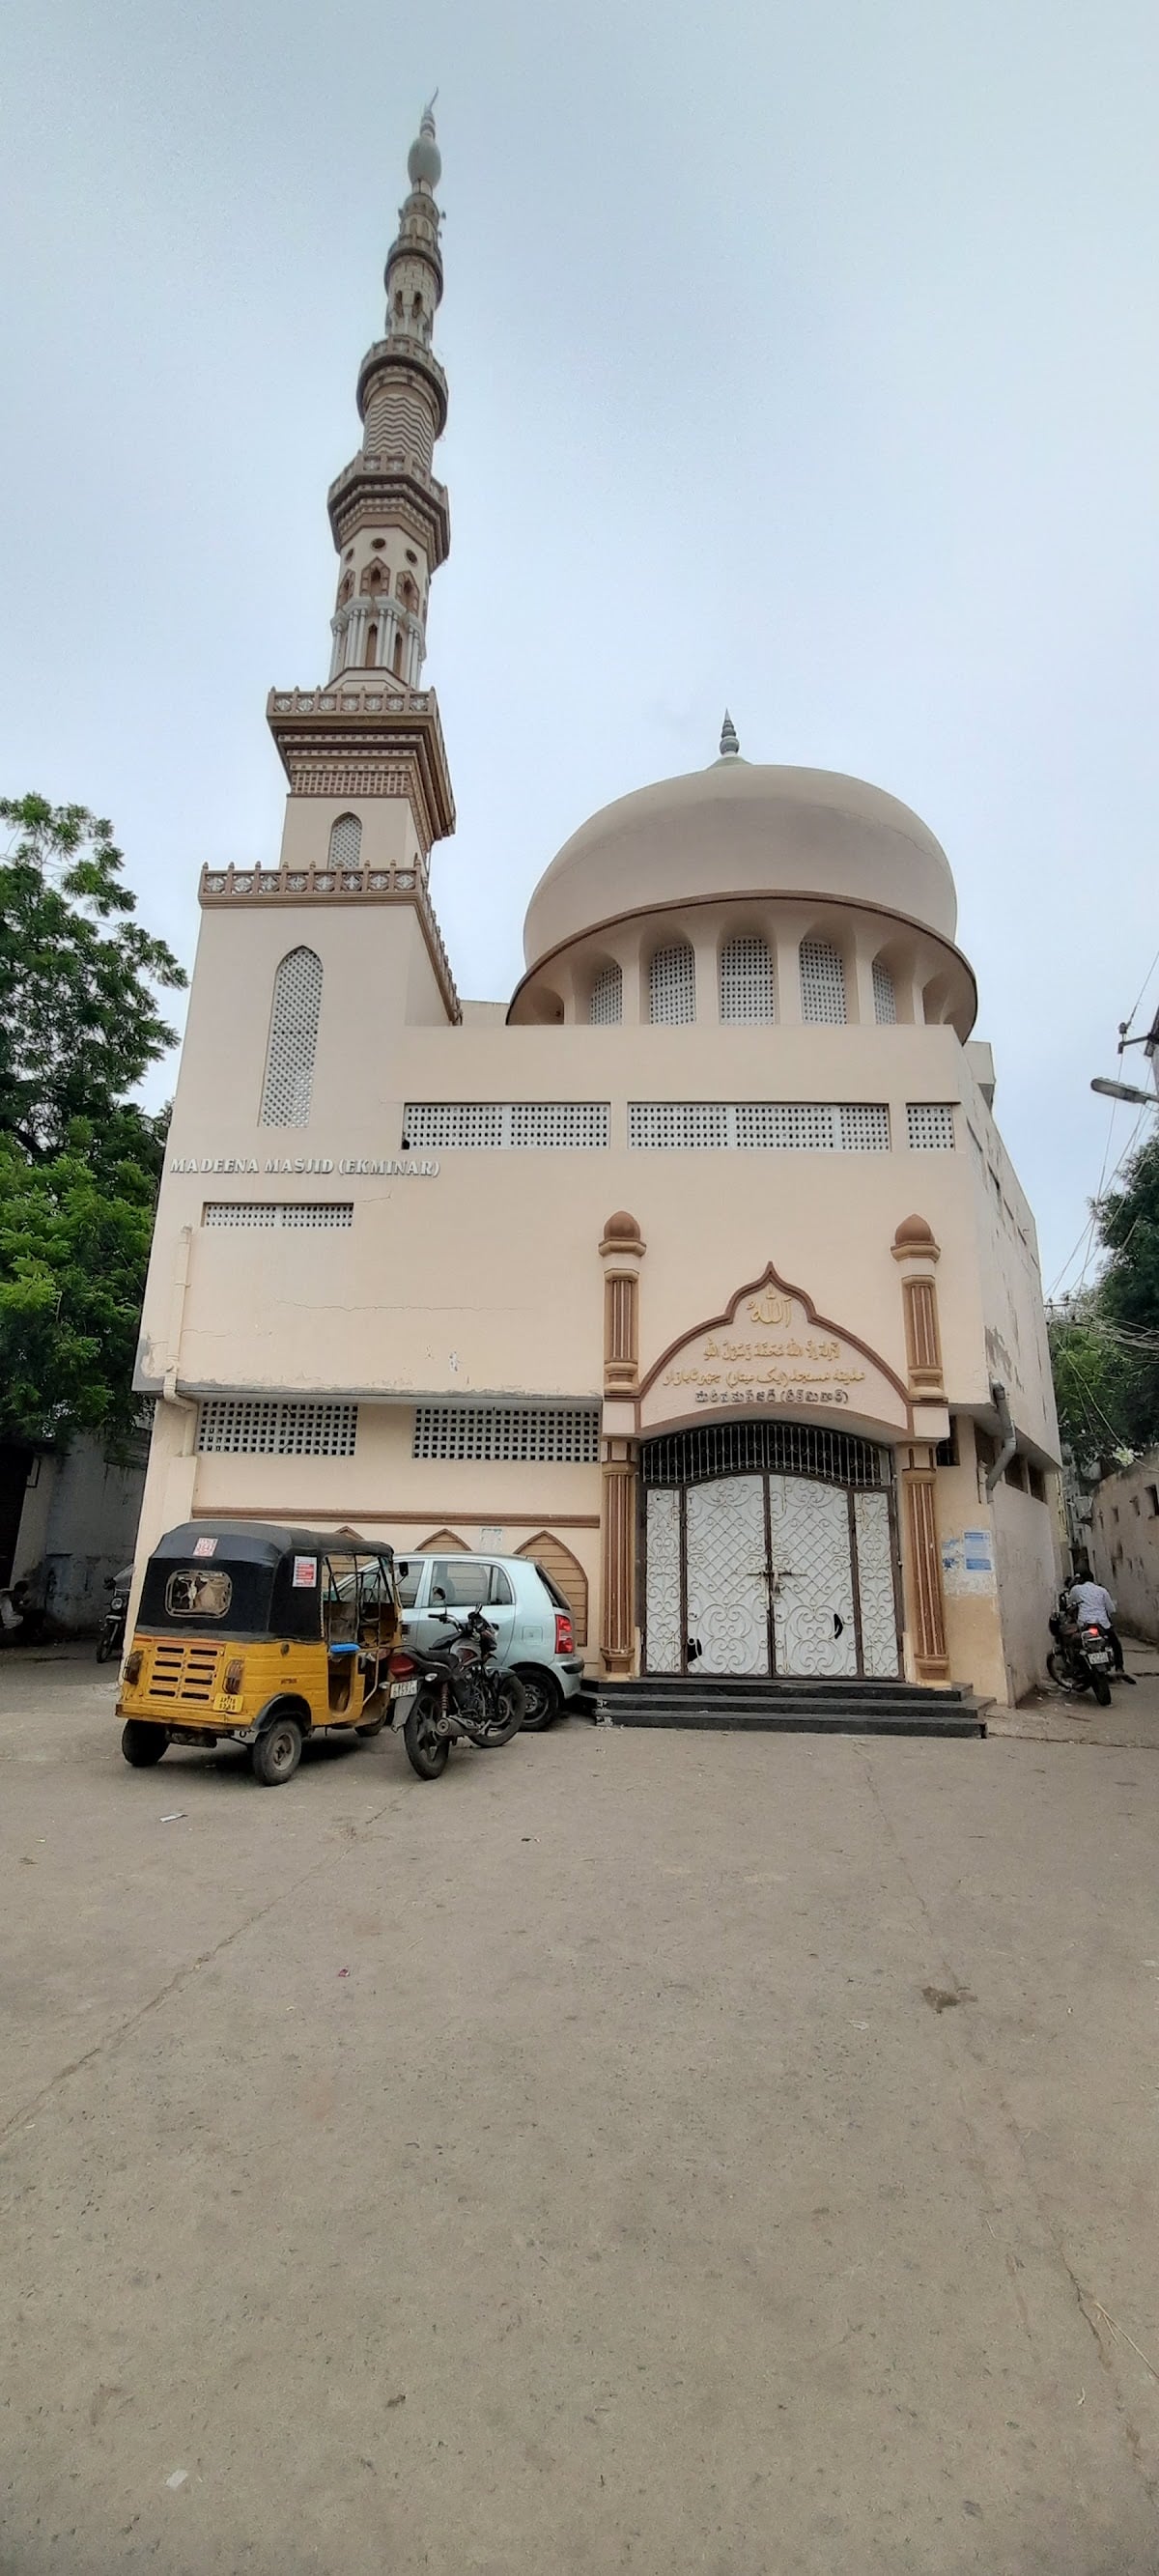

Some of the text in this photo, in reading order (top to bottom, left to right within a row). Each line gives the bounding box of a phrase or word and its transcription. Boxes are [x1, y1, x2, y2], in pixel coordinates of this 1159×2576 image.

[170, 1158, 440, 1177] MADEENA MASJID (EKMINAR)
